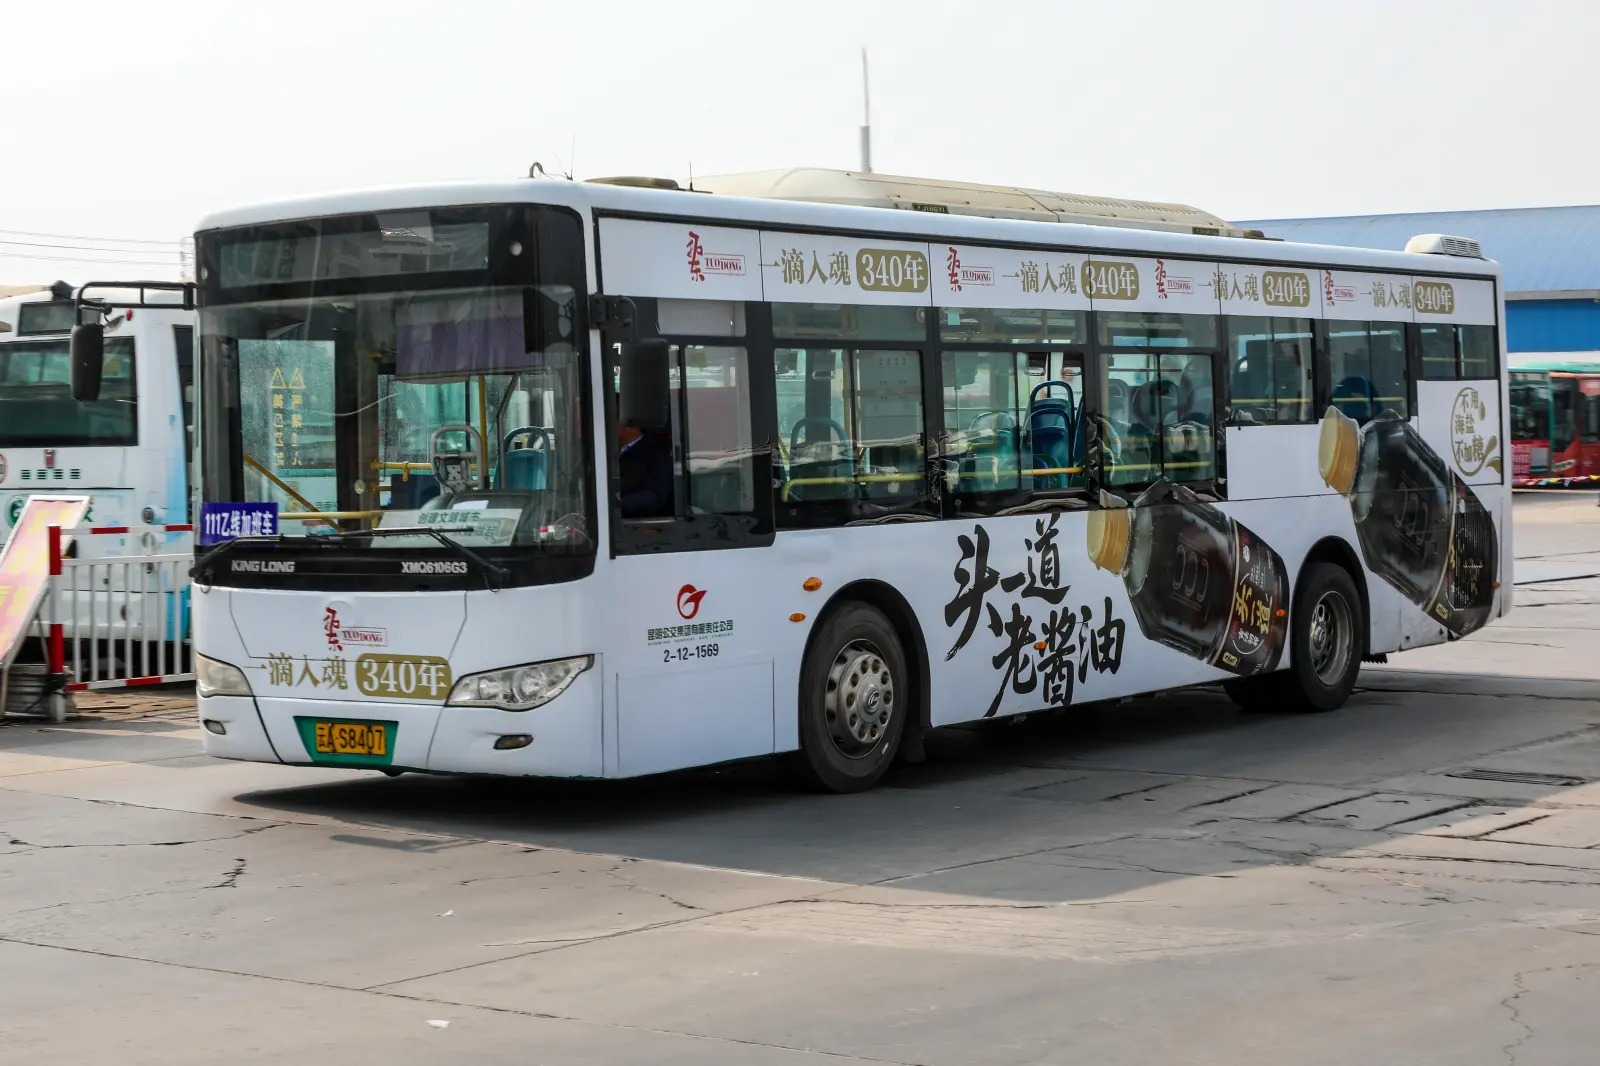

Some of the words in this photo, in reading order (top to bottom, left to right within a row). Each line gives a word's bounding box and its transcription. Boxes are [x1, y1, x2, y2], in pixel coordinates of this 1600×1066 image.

[861, 254, 924, 289] 340年
[1085, 264, 1136, 297] 340年
[1265, 275, 1309, 304] 340年
[1416, 285, 1453, 312] 340年
[205, 510, 273, 537] 111乙线加班车
[231, 560, 260, 573] KING
[261, 561, 295, 574] LONG
[401, 562, 468, 574] XMQ6106G3
[648, 619, 733, 640] 昆明公交集团有限责任公司
[664, 643, 719, 663] 2-12-1569
[361, 658, 447, 697] 340年
